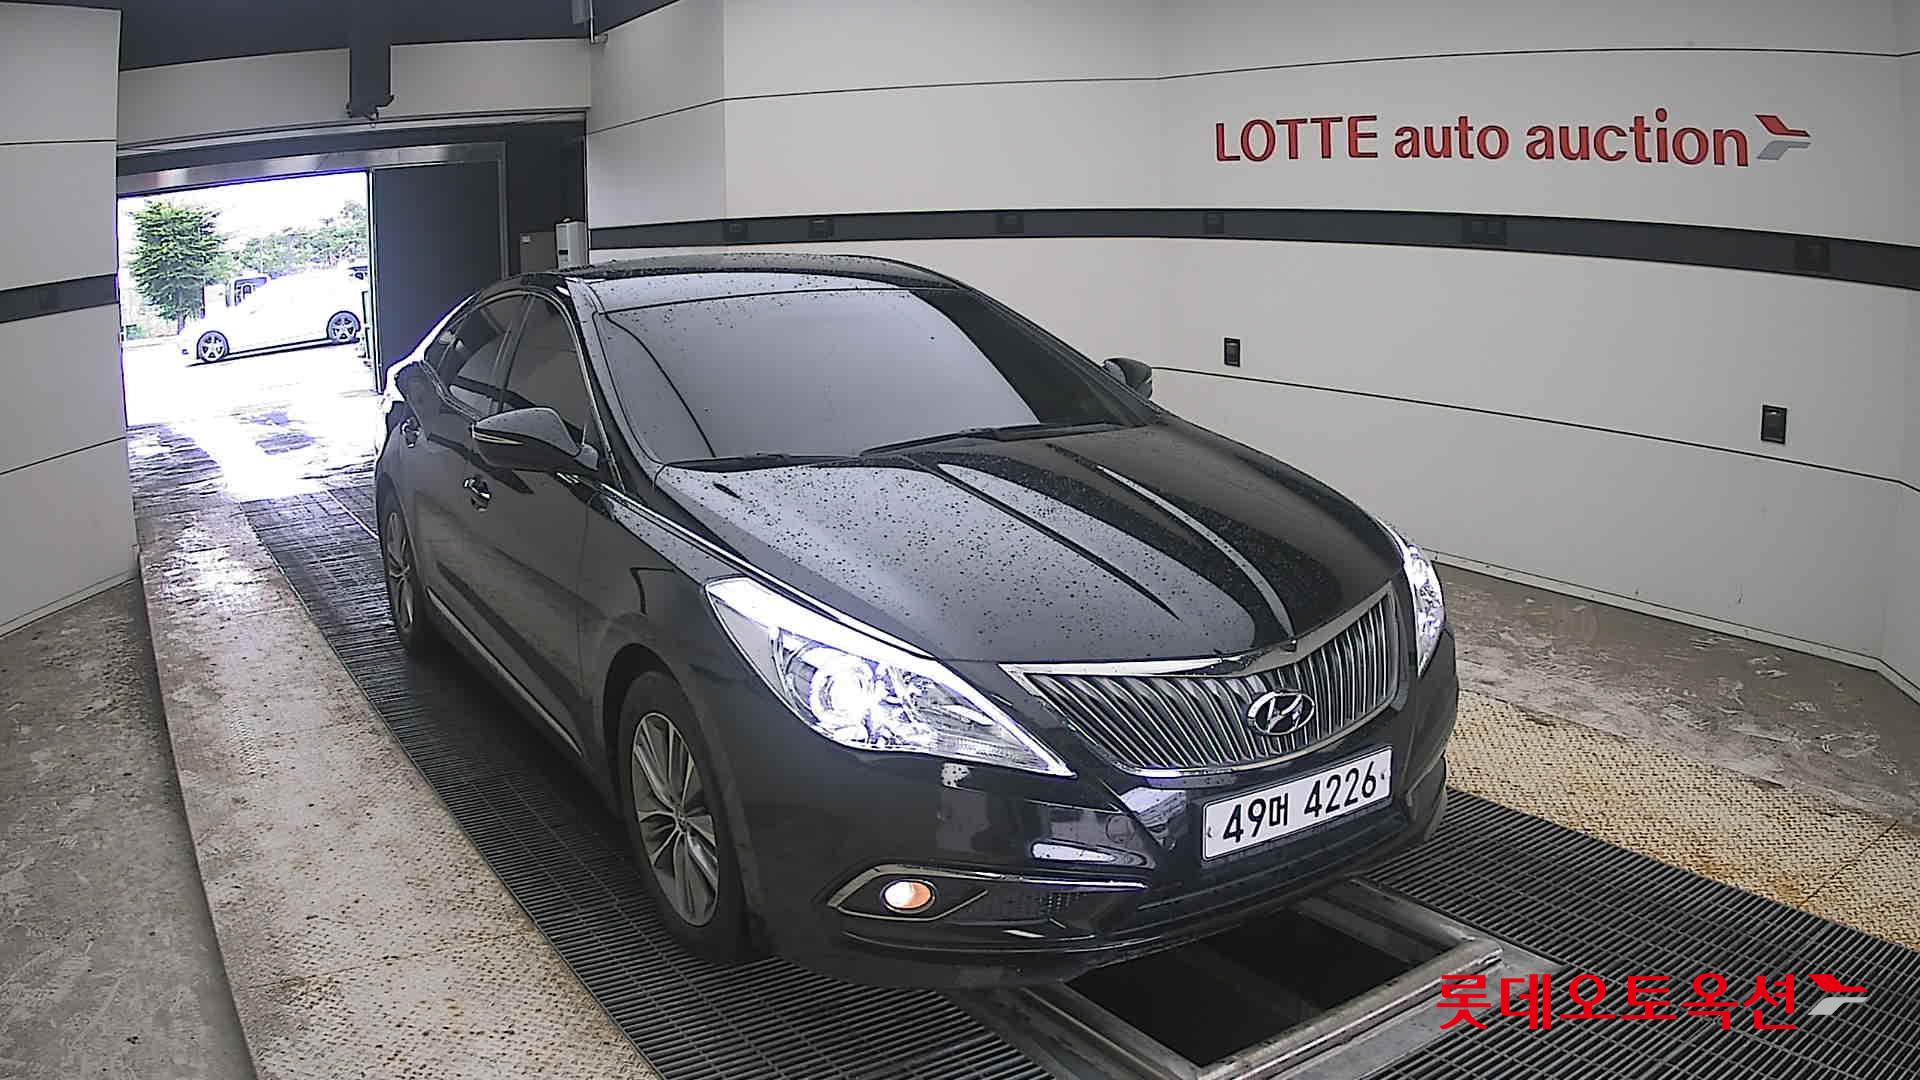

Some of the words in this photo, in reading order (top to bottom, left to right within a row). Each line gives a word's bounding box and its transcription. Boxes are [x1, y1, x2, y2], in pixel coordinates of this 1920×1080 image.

[1215, 115, 1378, 162] LOTTE
[1394, 115, 1509, 161] auto
[1525, 107, 1750, 167] auction
[1222, 792, 1289, 843] 49머
[1303, 761, 1377, 818] 4226
